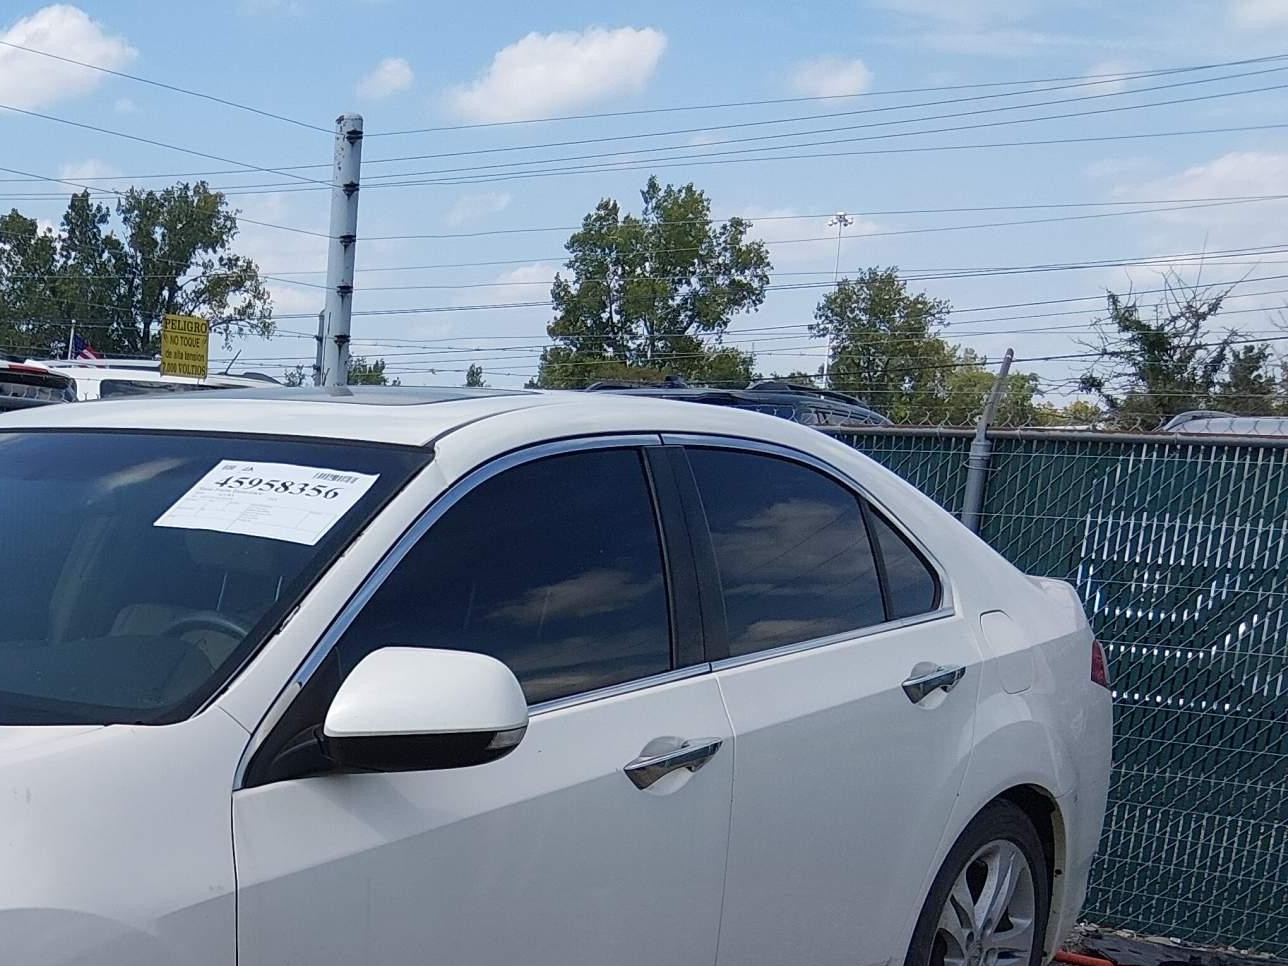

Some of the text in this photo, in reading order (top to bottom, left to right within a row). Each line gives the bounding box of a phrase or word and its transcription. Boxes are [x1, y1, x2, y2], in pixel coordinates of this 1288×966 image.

[165, 318, 207, 333] PELIGRO
[170, 335, 200, 348] NO TOQUE
[178, 364, 205, 375] VOLTIOS
[215, 476, 344, 499] 45958356
